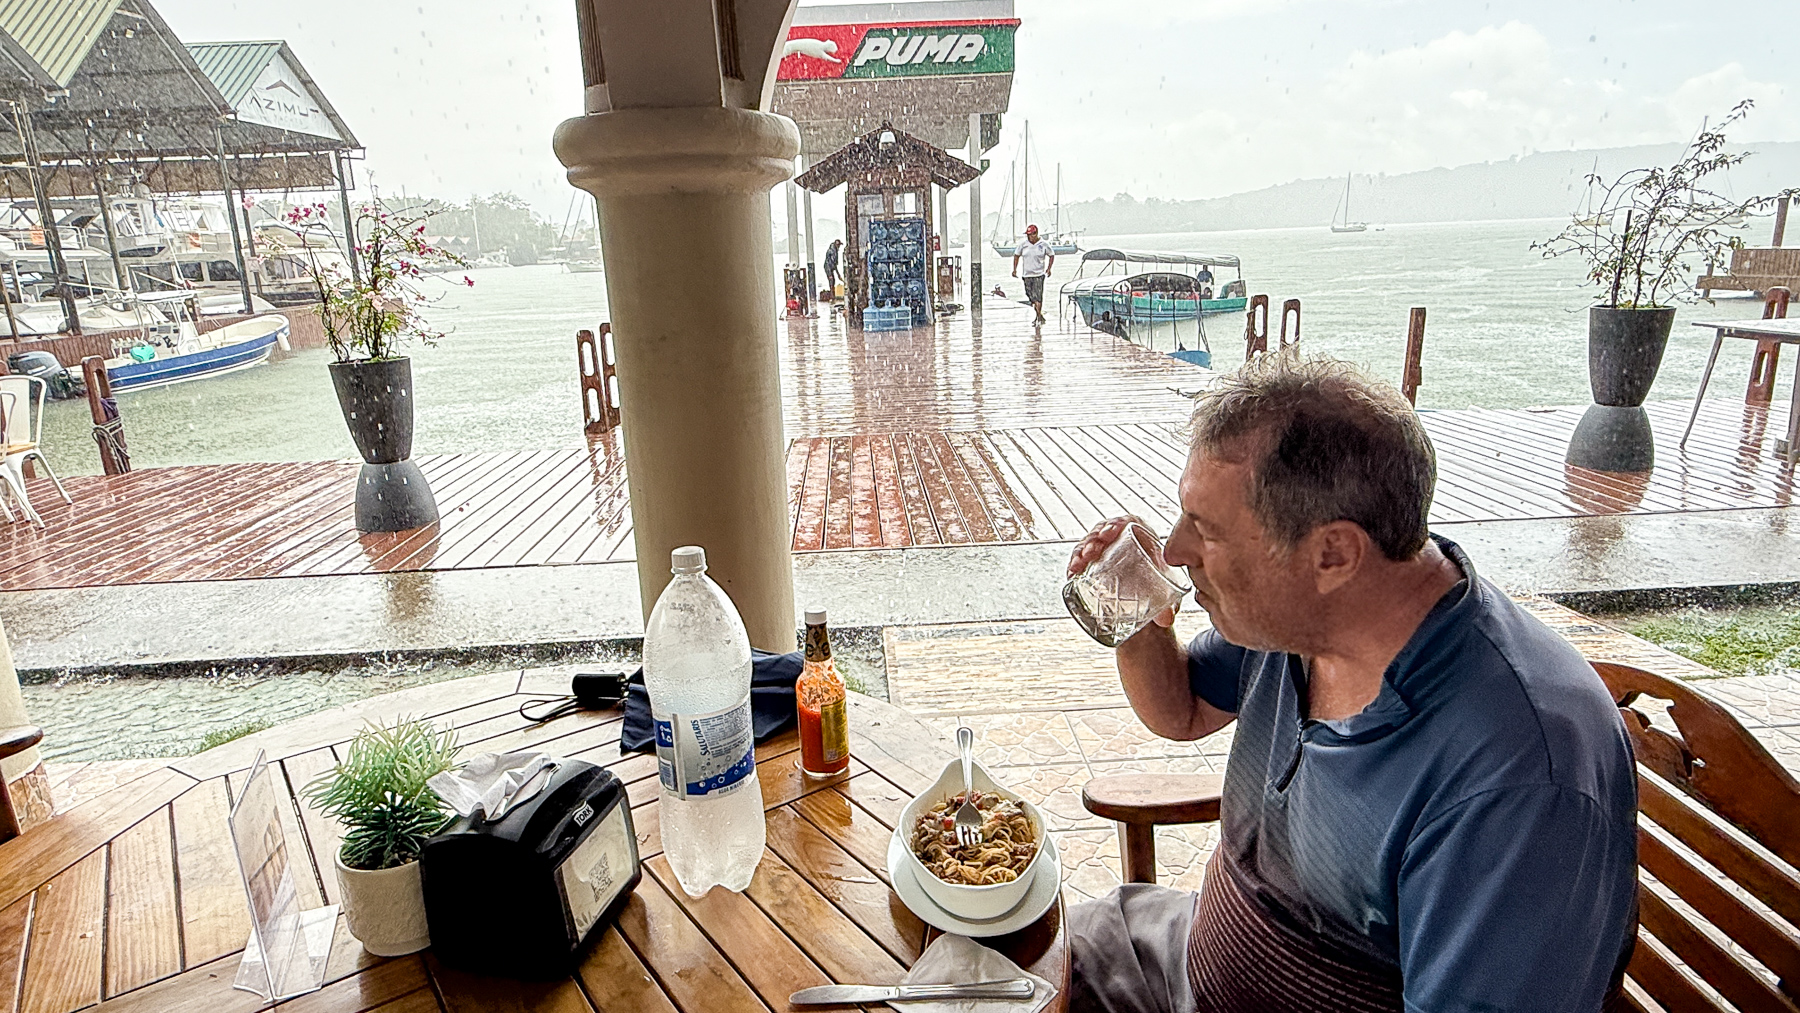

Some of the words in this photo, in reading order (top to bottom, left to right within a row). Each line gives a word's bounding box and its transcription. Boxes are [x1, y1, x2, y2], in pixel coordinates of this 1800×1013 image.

[853, 34, 985, 67] PUMA
[691, 719, 710, 756] SALUTARIS
[575, 806, 593, 826] TORK
